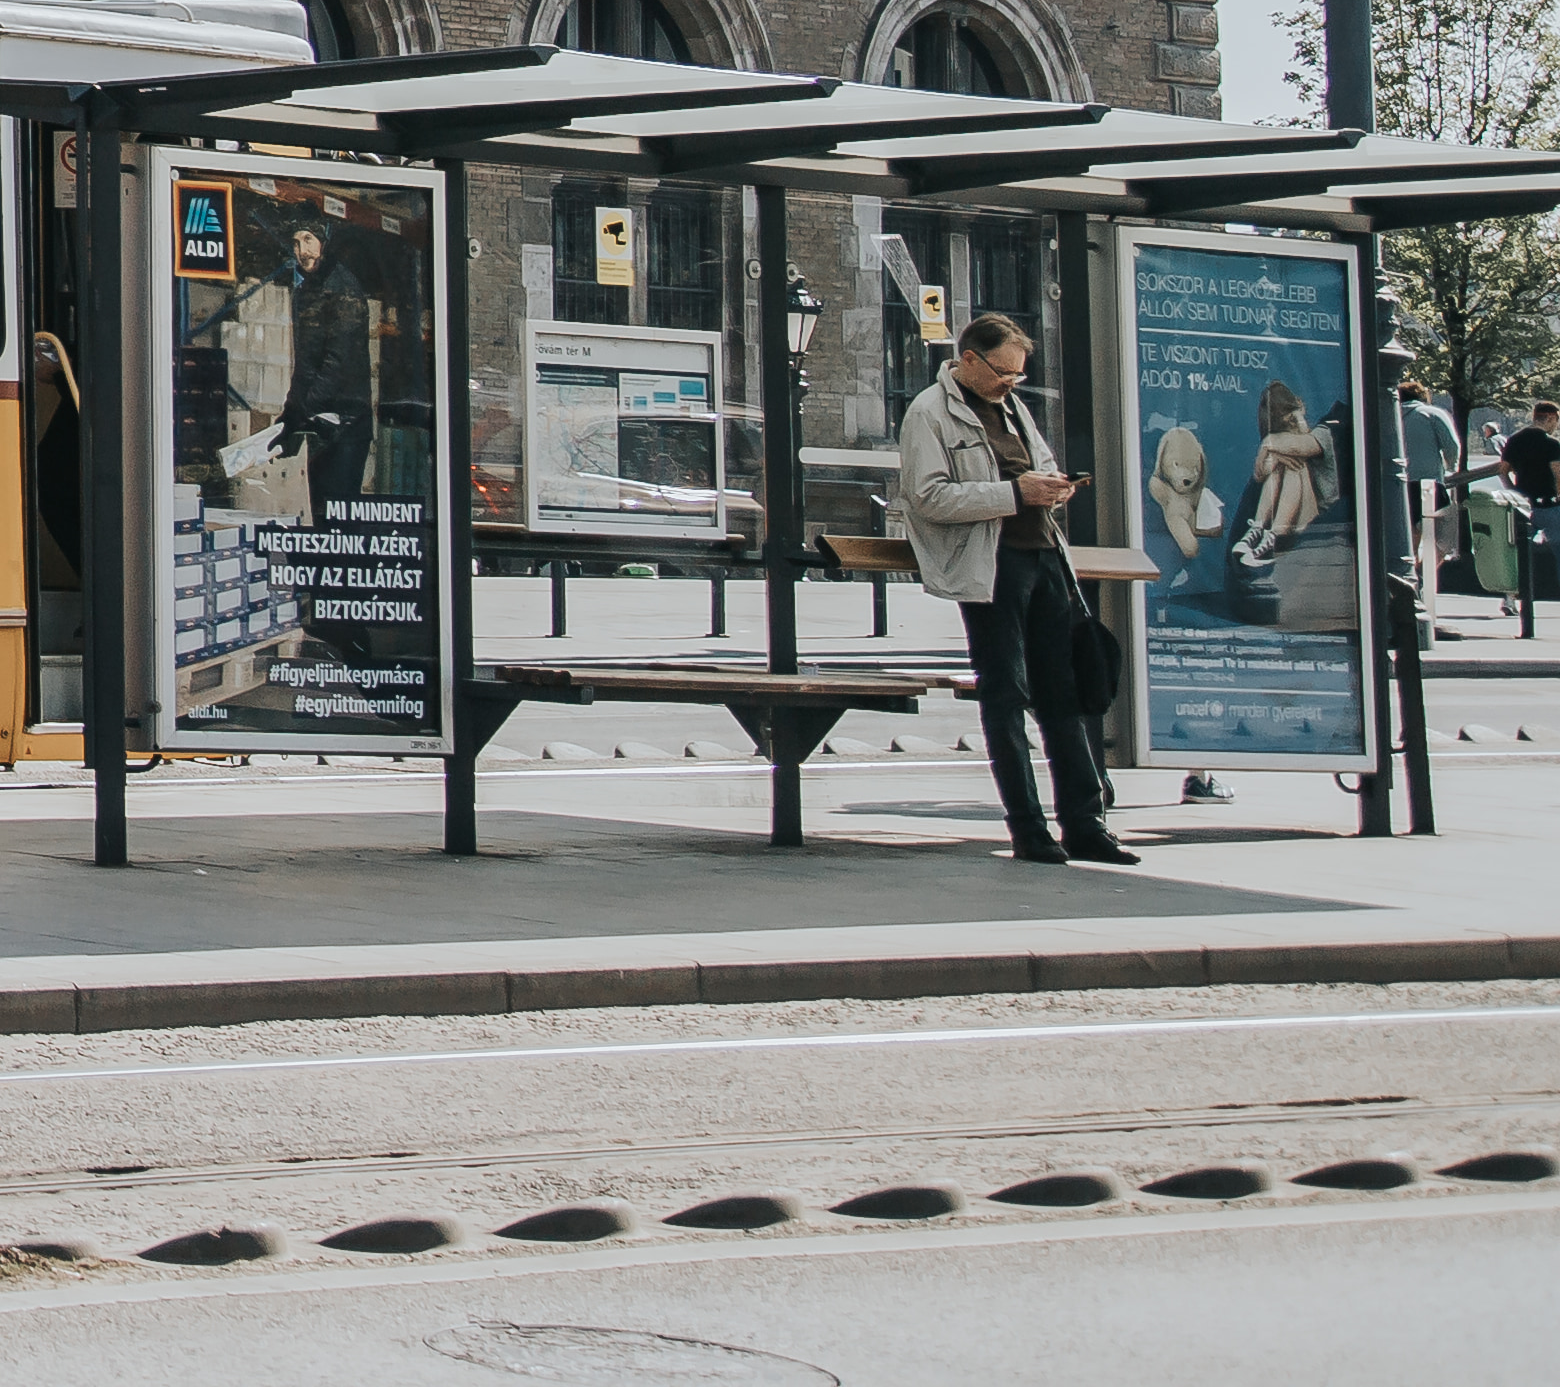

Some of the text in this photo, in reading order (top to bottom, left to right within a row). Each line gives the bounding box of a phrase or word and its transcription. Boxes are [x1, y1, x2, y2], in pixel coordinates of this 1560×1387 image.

[185, 239, 224, 258] ALDI
[1137, 272, 1204, 294] SOKSZOR
[1208, 278, 1219, 295] A
[1138, 294, 1185, 319] ÁLLÓK
[1187, 301, 1217, 322] SEM
[1221, 304, 1277, 326] TUDNAK
[566, 345, 579, 356] tér
[582, 346, 591, 357] M
[1139, 342, 1269, 370] TE VISZONT TUDSZ
[1140, 369, 1182, 389] ADÓD
[326, 500, 422, 523] MI MINDENT
[258, 528, 422, 560] MEGTESZÜNK AZÉRT,
[270, 561, 422, 589] HOGY AZ ELLÁTÁST
[315, 594, 423, 622] BIZTOSÍTSUK.
[269, 663, 424, 689] #figyeljünkegymásra
[188, 694, 424, 719] aldi.hu #együttmennifog
[1175, 700, 1210, 717] unicef
[1228, 704, 1268, 719] minden
